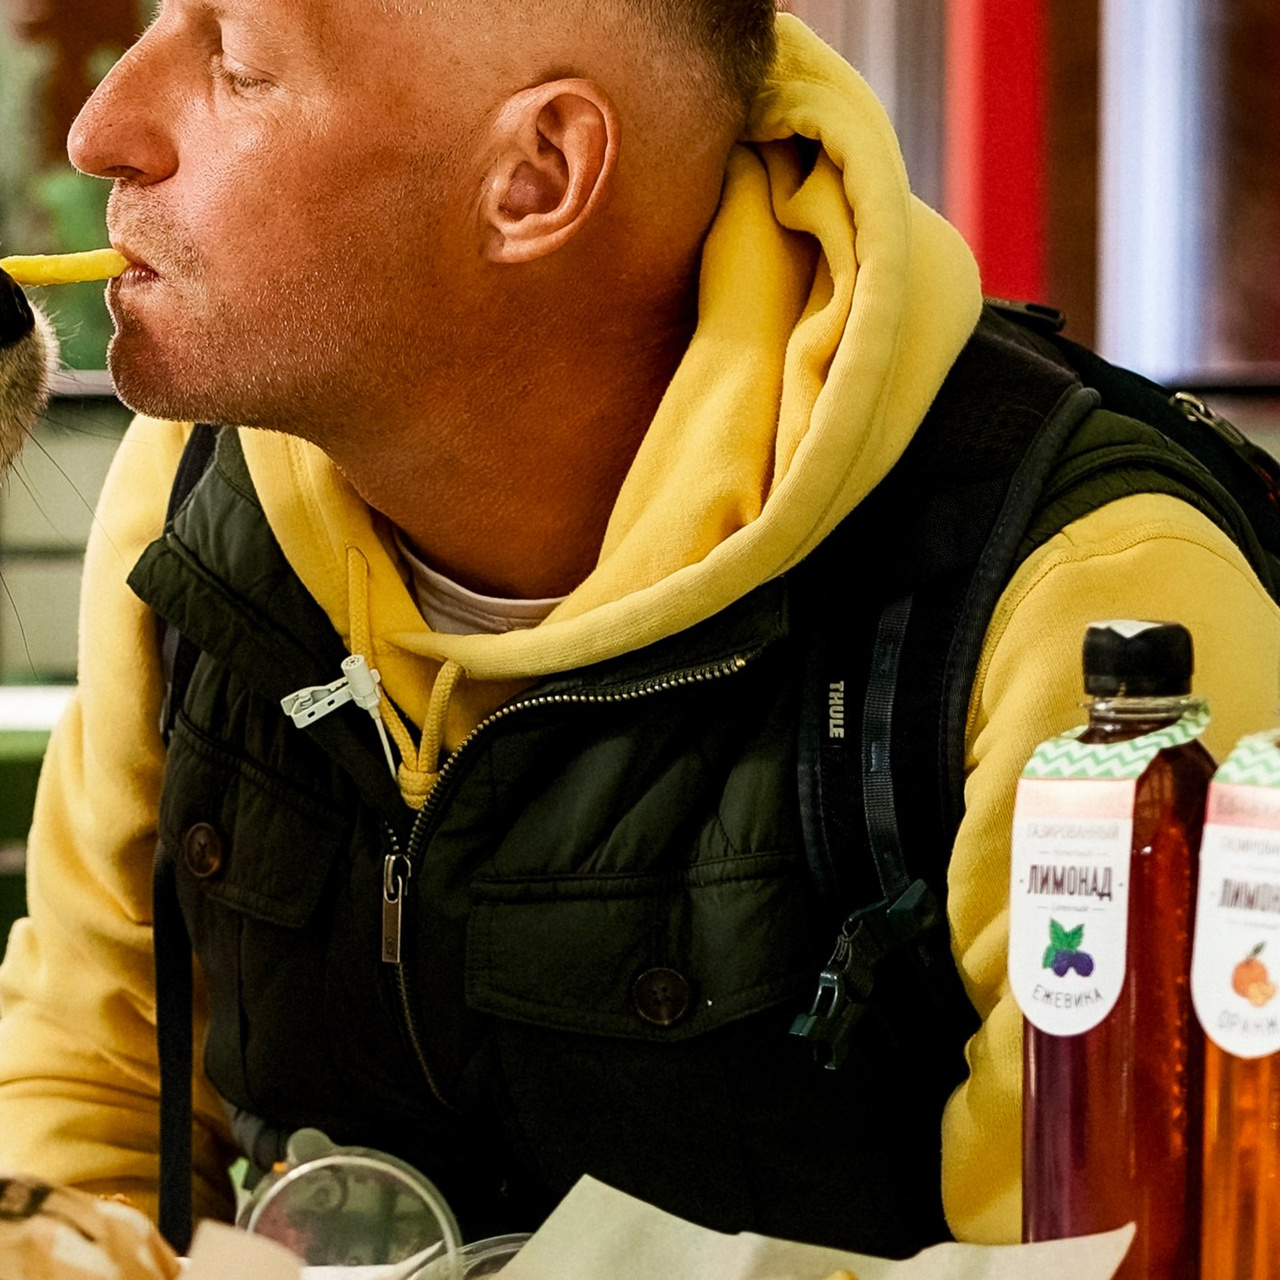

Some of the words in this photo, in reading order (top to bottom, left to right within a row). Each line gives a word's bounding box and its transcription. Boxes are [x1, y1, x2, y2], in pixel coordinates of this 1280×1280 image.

[829, 681, 844, 738] THULE
[1027, 865, 1114, 902] ЛИМОНАД
[1032, 983, 1104, 1009] ЕЖЕВИКА
